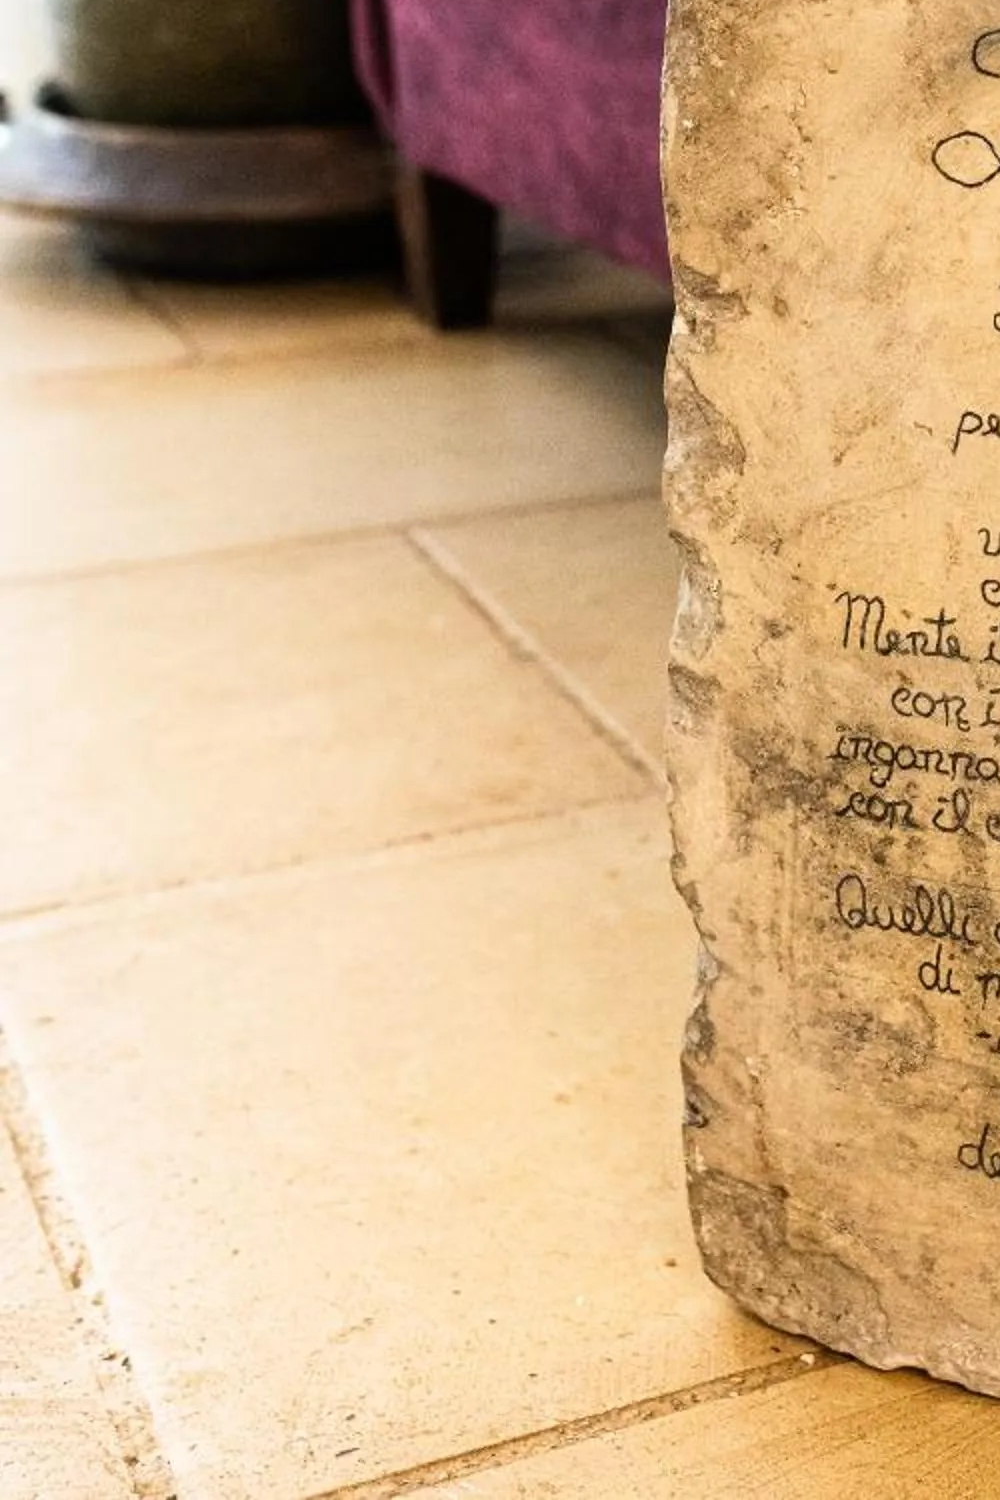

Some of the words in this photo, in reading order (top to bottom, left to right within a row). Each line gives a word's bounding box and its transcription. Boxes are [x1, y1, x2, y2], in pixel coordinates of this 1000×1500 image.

[835, 590, 969, 663] Mente
[892, 686, 971, 732] con
[837, 790, 917, 832] con
[932, 787, 975, 835] il
[834, 873, 977, 944] Quelli
[917, 944, 961, 995] di
